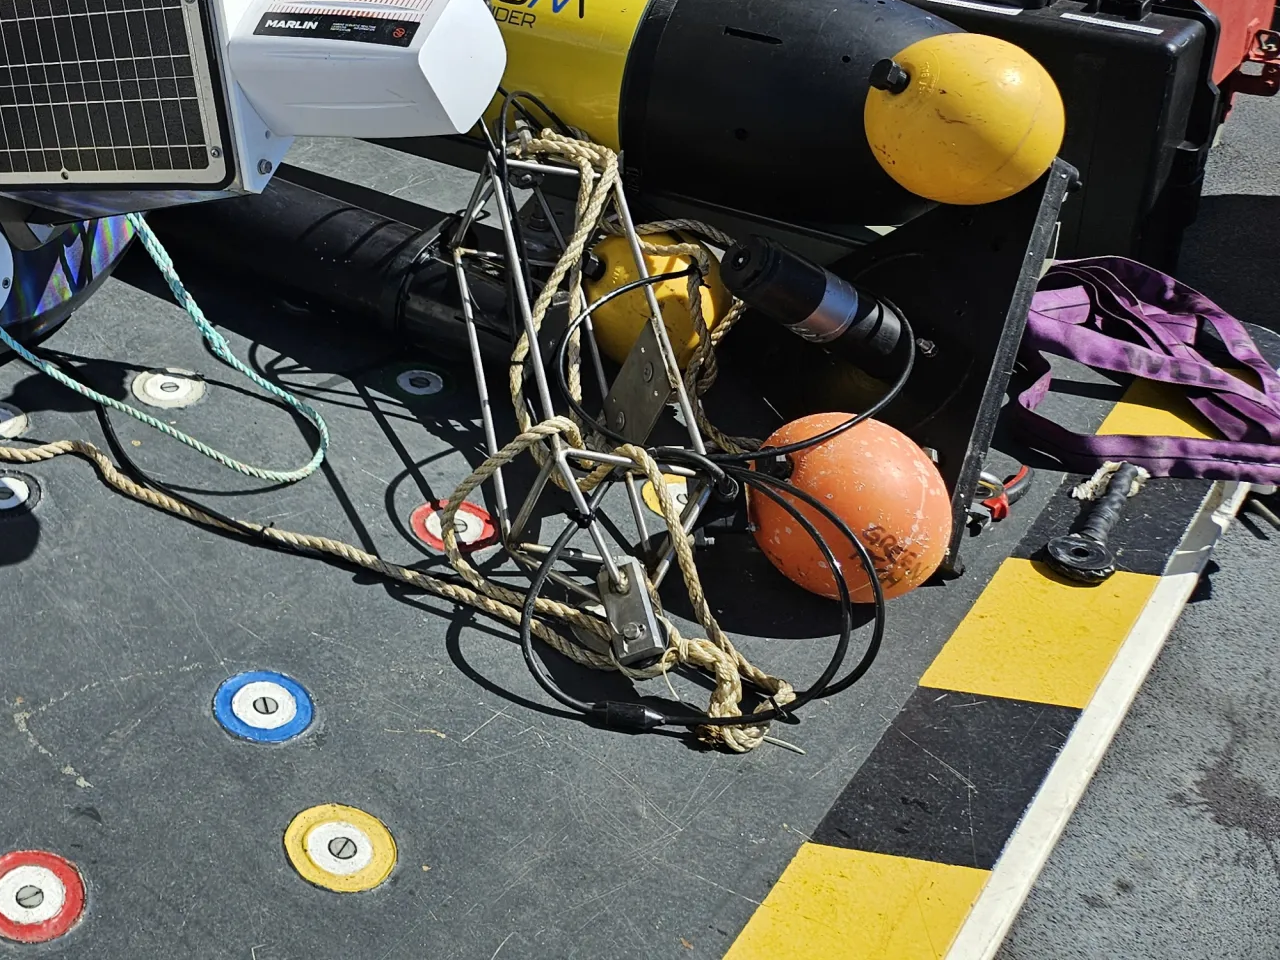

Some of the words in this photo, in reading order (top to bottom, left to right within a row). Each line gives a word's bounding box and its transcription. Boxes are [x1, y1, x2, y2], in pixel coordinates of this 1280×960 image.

[264, 19, 319, 30] MARLIN
[492, 5, 536, 29] IDER
[862, 525, 930, 581] GREEN
